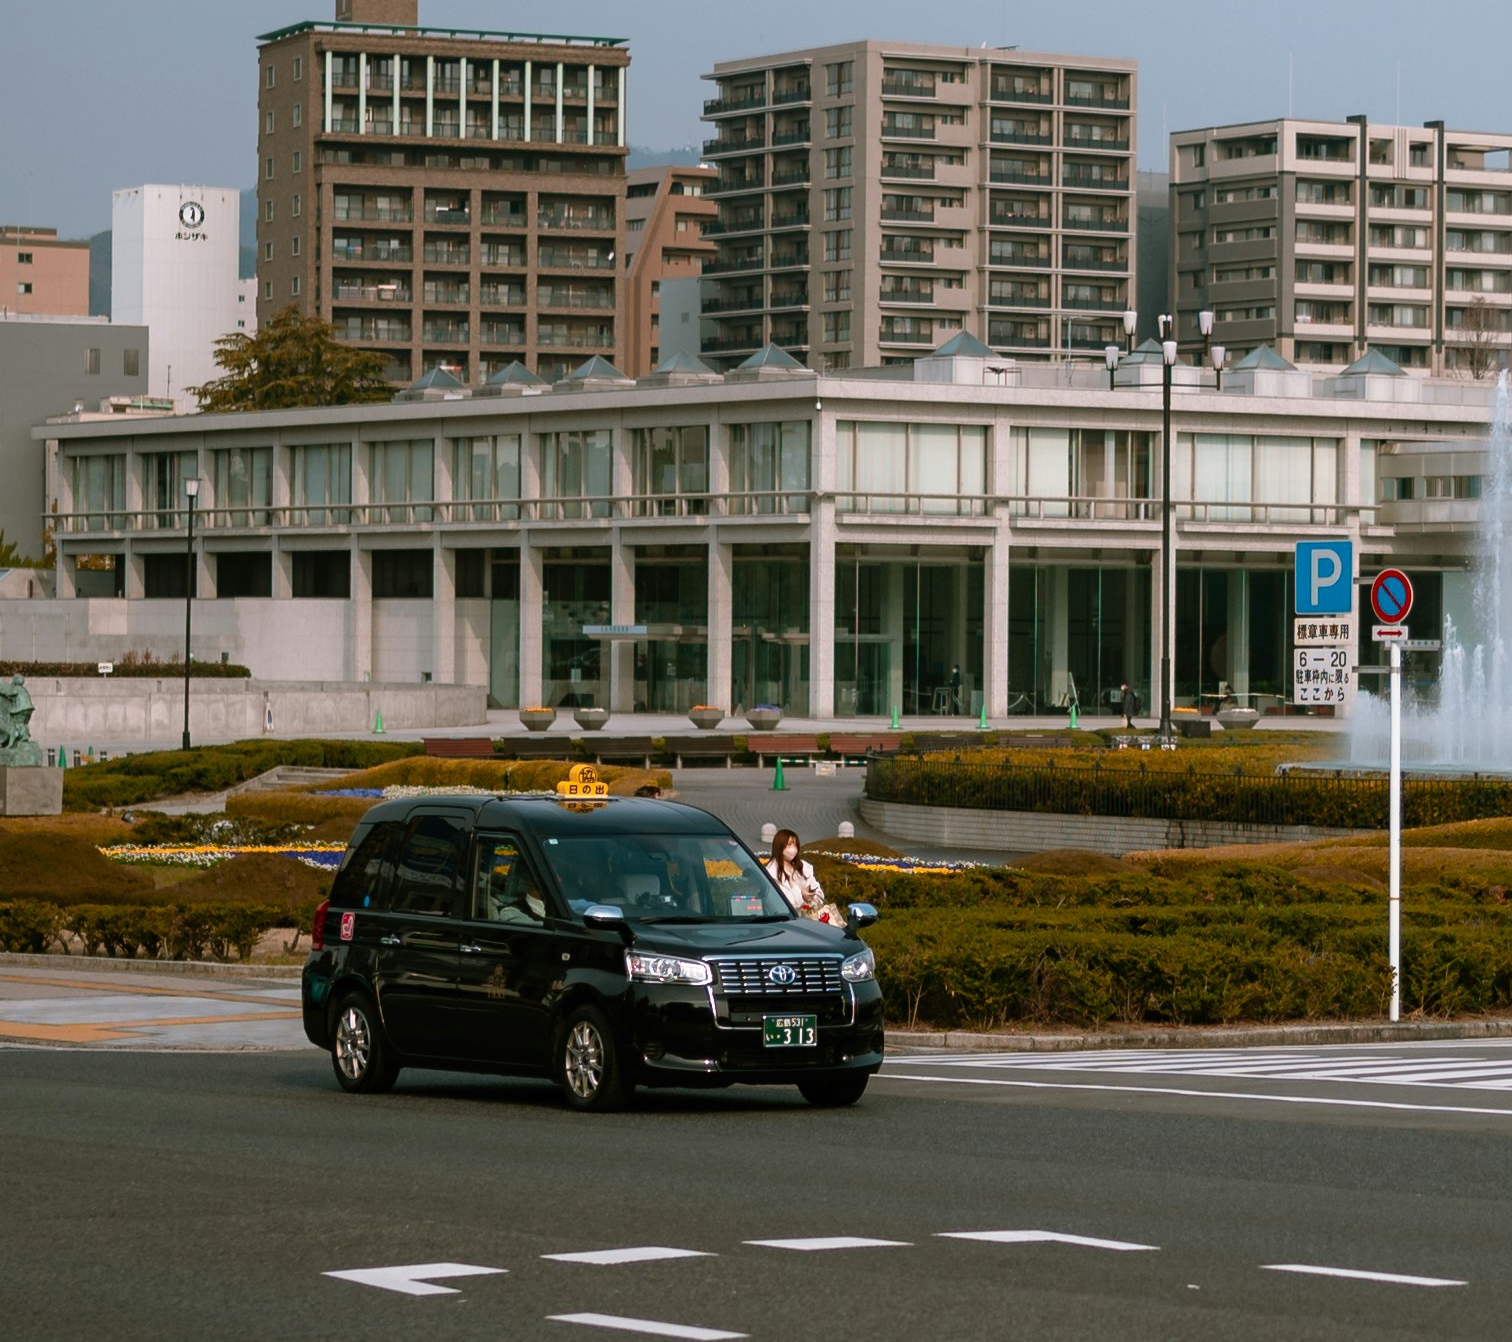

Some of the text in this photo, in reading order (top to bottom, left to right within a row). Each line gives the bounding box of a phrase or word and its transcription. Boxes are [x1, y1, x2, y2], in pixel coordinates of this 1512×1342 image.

[1311, 549, 1342, 606] P
[1297, 624, 1349, 640] 標章車専用
[1296, 669, 1349, 685] 駐車枠内に限る
[1300, 688, 1345, 701] ここから
[569, 785, 604, 795] 日の出
